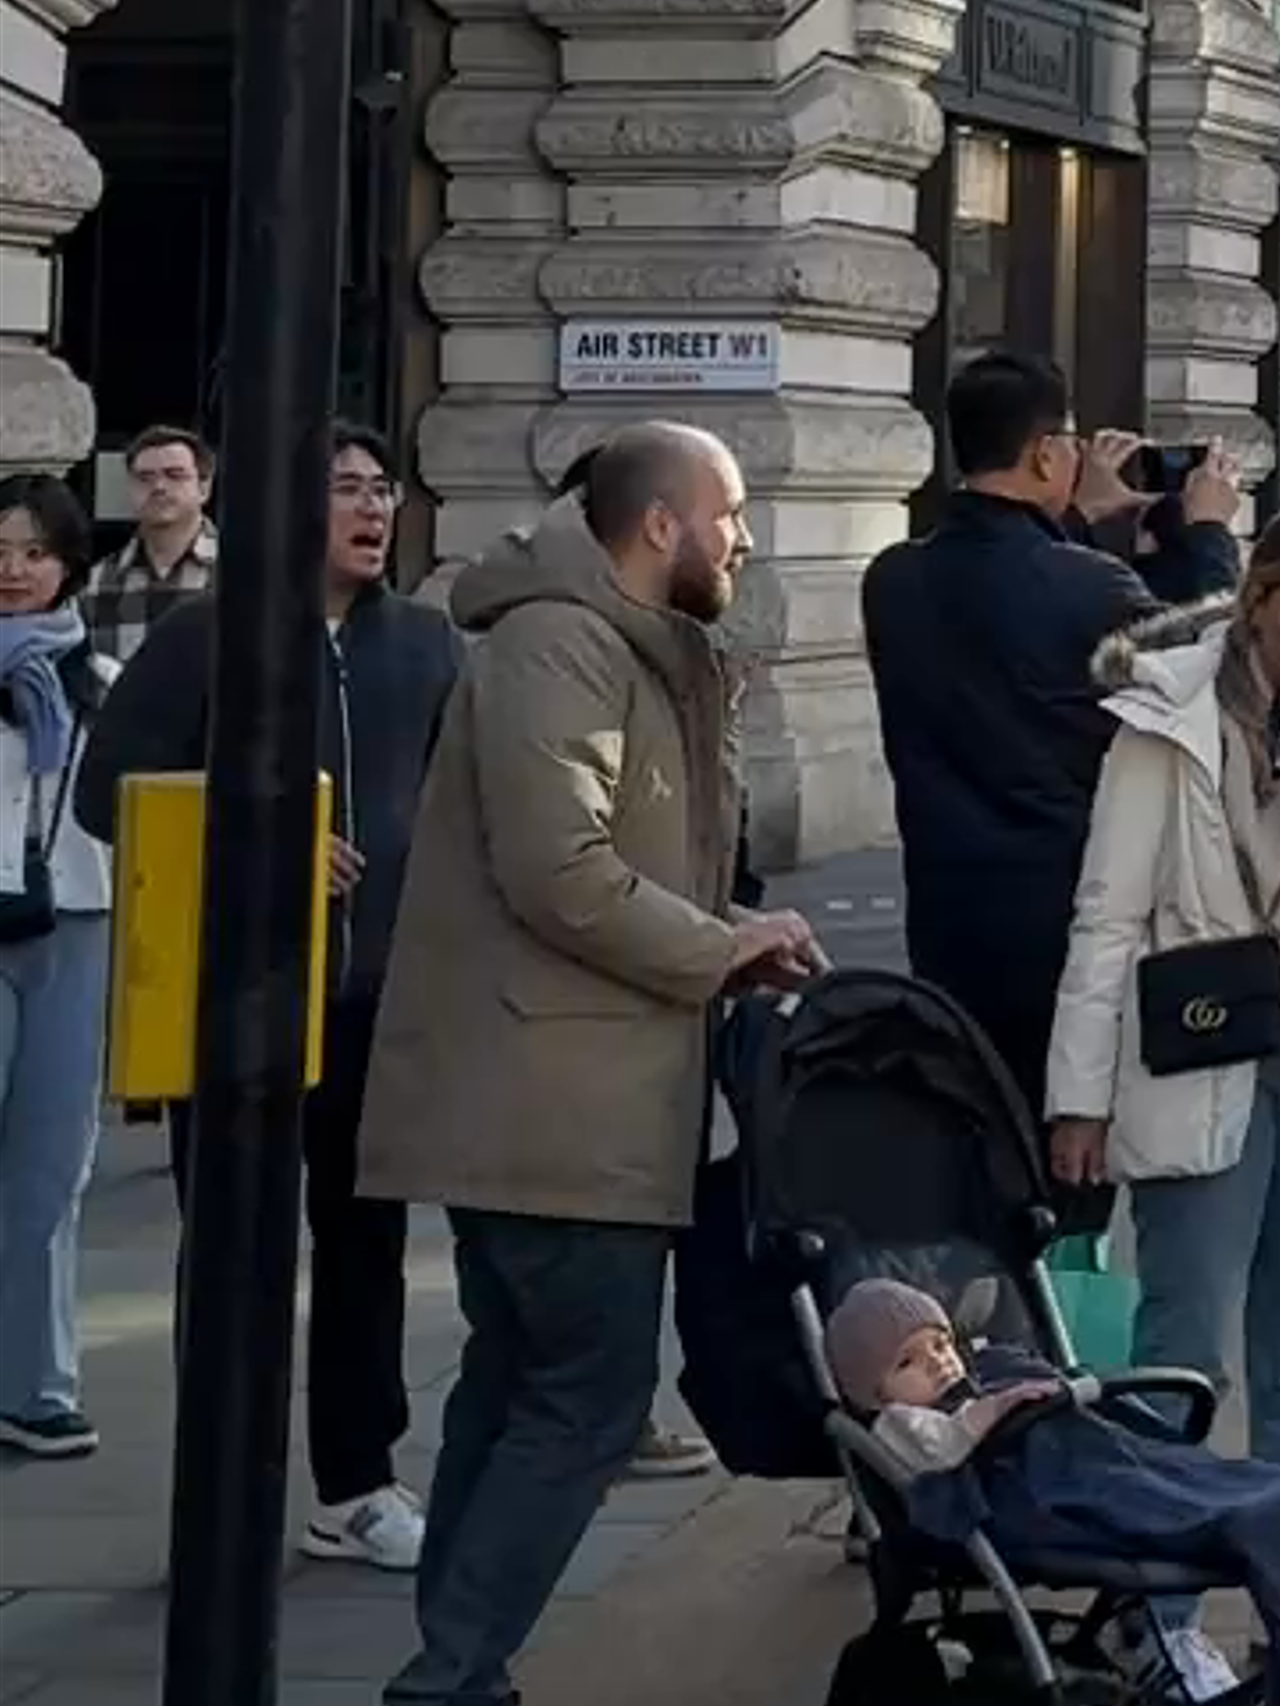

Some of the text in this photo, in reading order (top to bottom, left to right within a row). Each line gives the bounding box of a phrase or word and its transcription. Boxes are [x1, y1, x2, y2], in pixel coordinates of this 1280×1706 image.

[577, 332, 768, 359] AIR STREET W1
